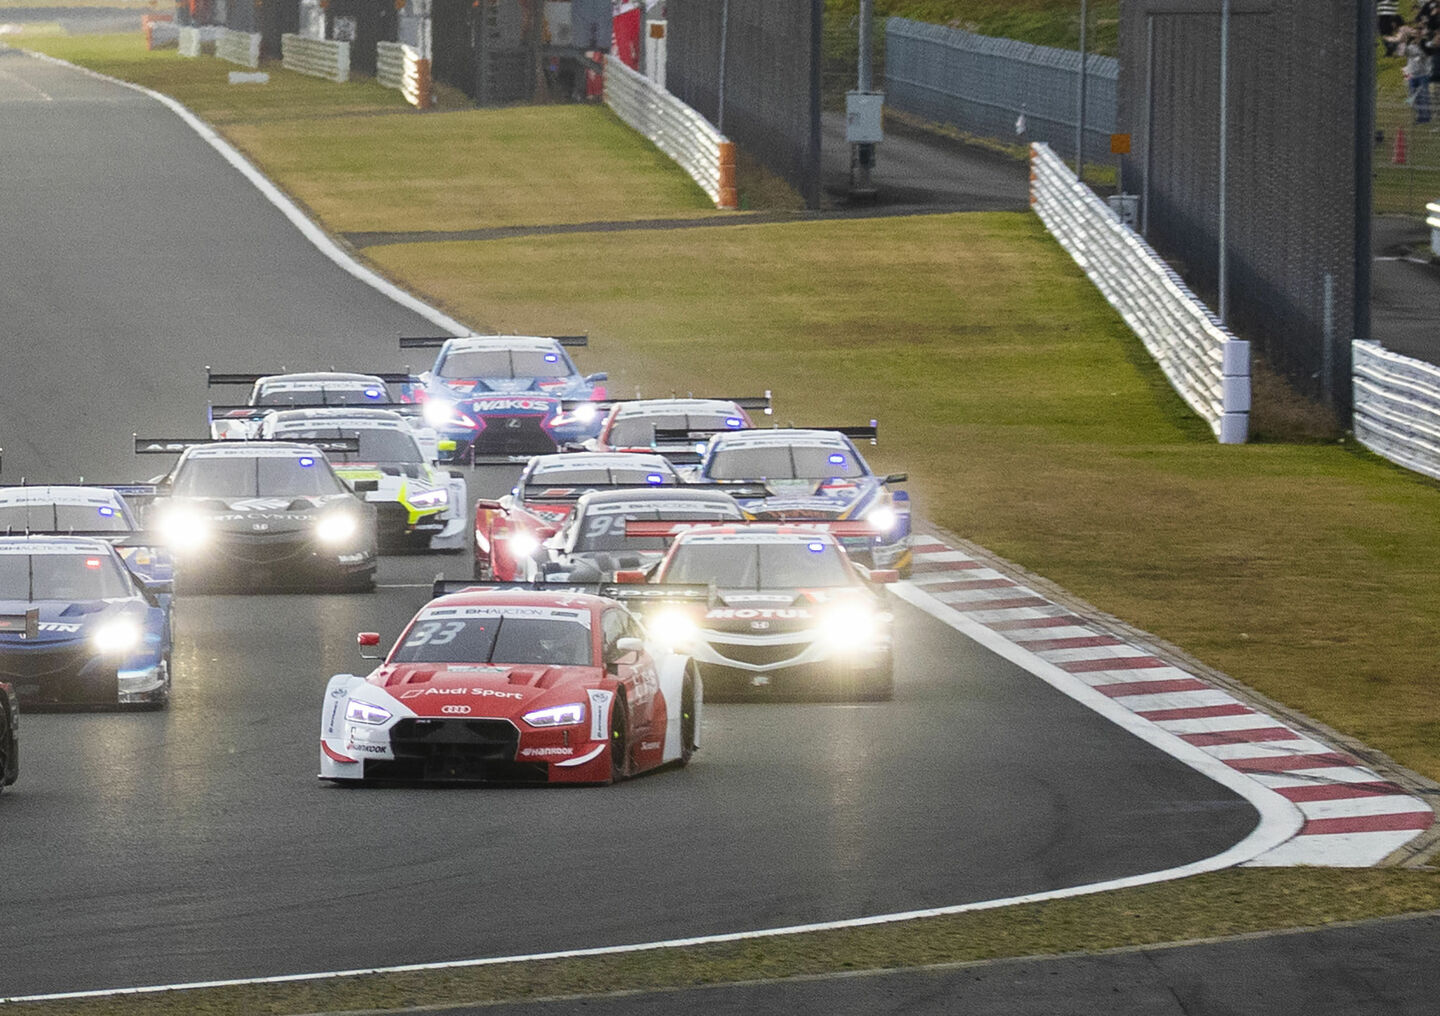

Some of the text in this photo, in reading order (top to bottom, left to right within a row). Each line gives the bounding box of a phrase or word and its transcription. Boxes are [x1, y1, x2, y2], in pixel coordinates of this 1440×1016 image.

[706, 609, 813, 618] MOTUL
[404, 621, 466, 647] 33
[423, 687, 524, 701] Audi Sport
